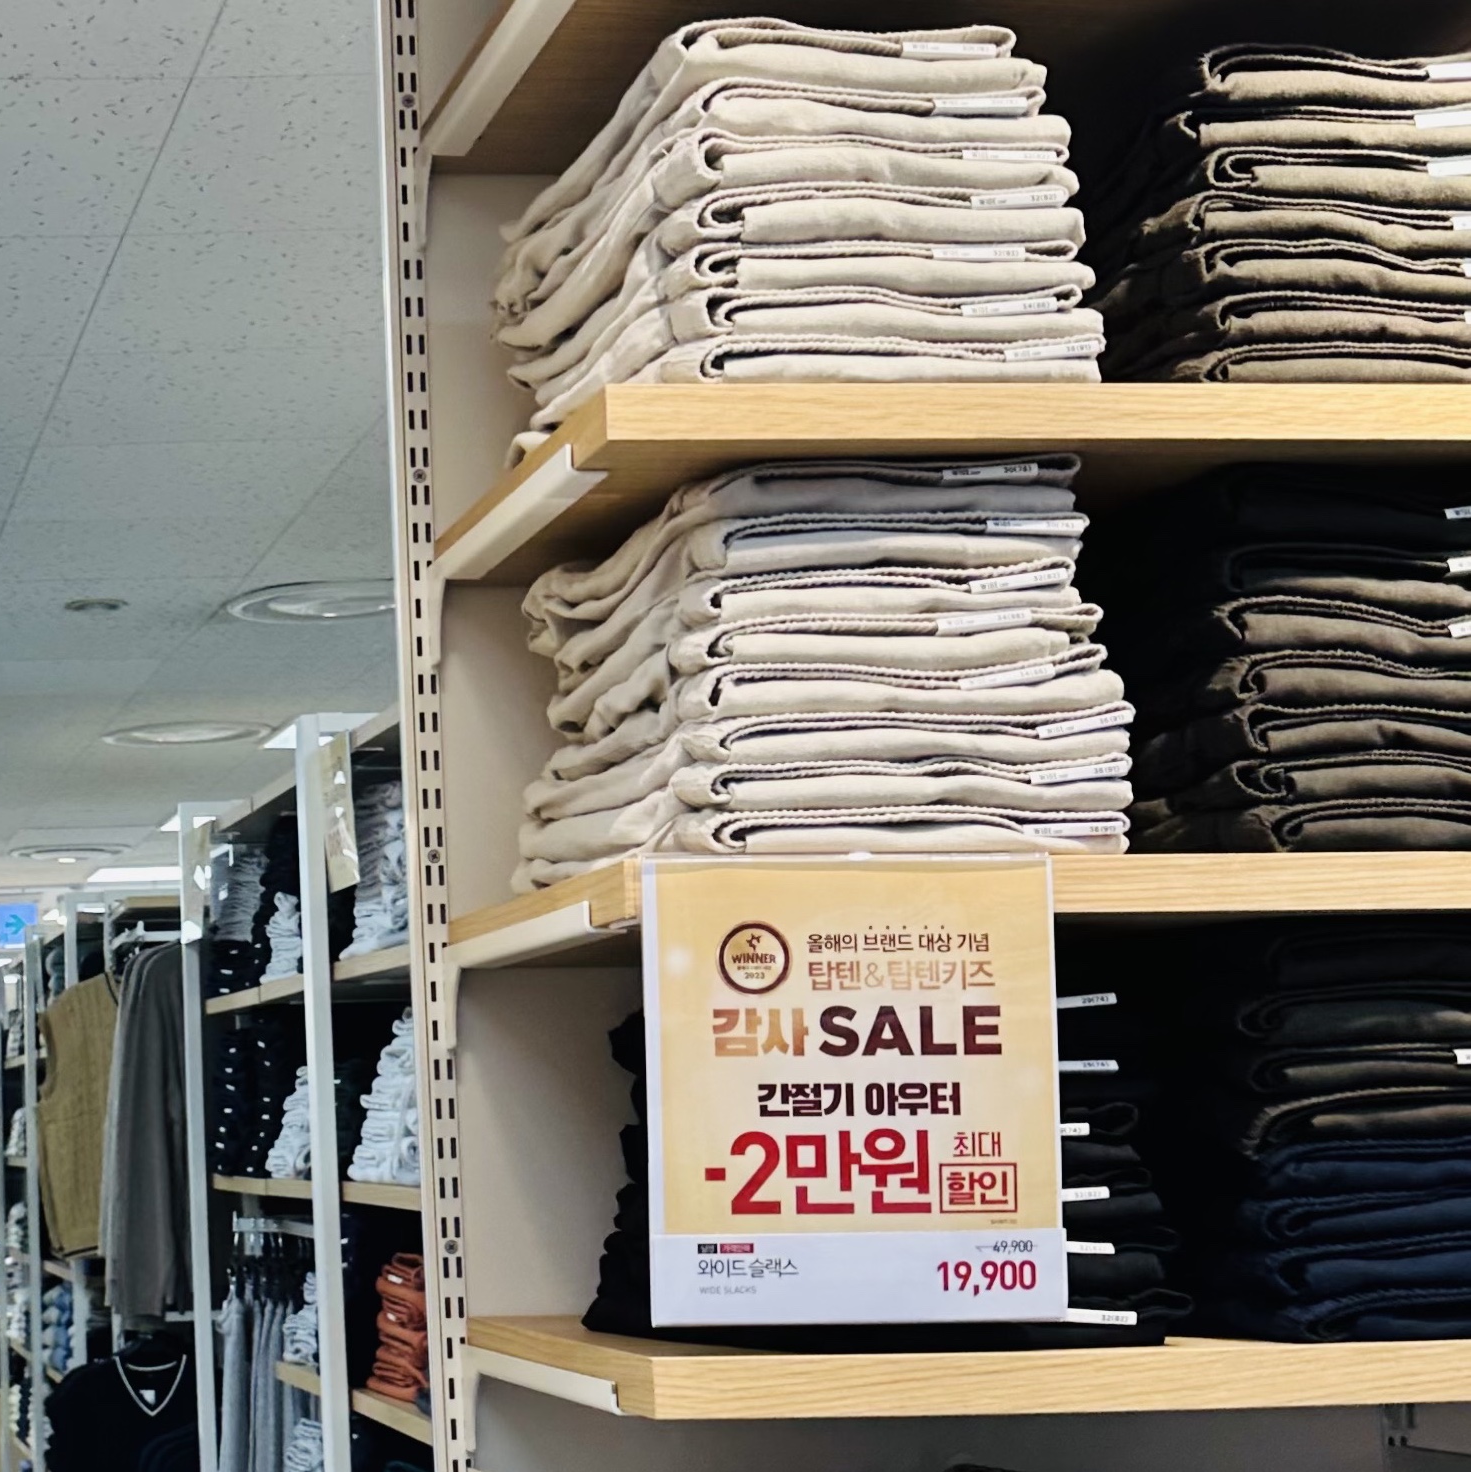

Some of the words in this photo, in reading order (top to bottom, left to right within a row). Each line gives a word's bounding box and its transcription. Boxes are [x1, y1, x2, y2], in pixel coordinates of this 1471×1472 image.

[807, 932, 858, 954] 올해의
[863, 933, 914, 953] 브랜드
[918, 933, 952, 953] 대상
[957, 932, 990, 953] 기념
[731, 952, 777, 964] WINNER
[744, 972, 766, 980] 2023
[807, 960, 996, 991] 탑텐&탑텐키즈
[712, 1007, 809, 1057] 감사
[819, 1004, 1003, 1057] SALE
[757, 1083, 855, 1117] 간절기
[864, 1081, 962, 1116] 아우터
[952, 1131, 1002, 1158] 최대
[704, 1127, 932, 1216] -2만원
[946, 1170, 1009, 1206] 할인
[992, 1239, 1034, 1255] 49,900
[697, 1258, 748, 1279] 와이드
[748, 1258, 799, 1278] 슬랙스
[936, 1259, 1037, 1297] 19,900
[699, 1286, 721, 1295] WIDE
[723, 1285, 757, 1295] SLACKS
